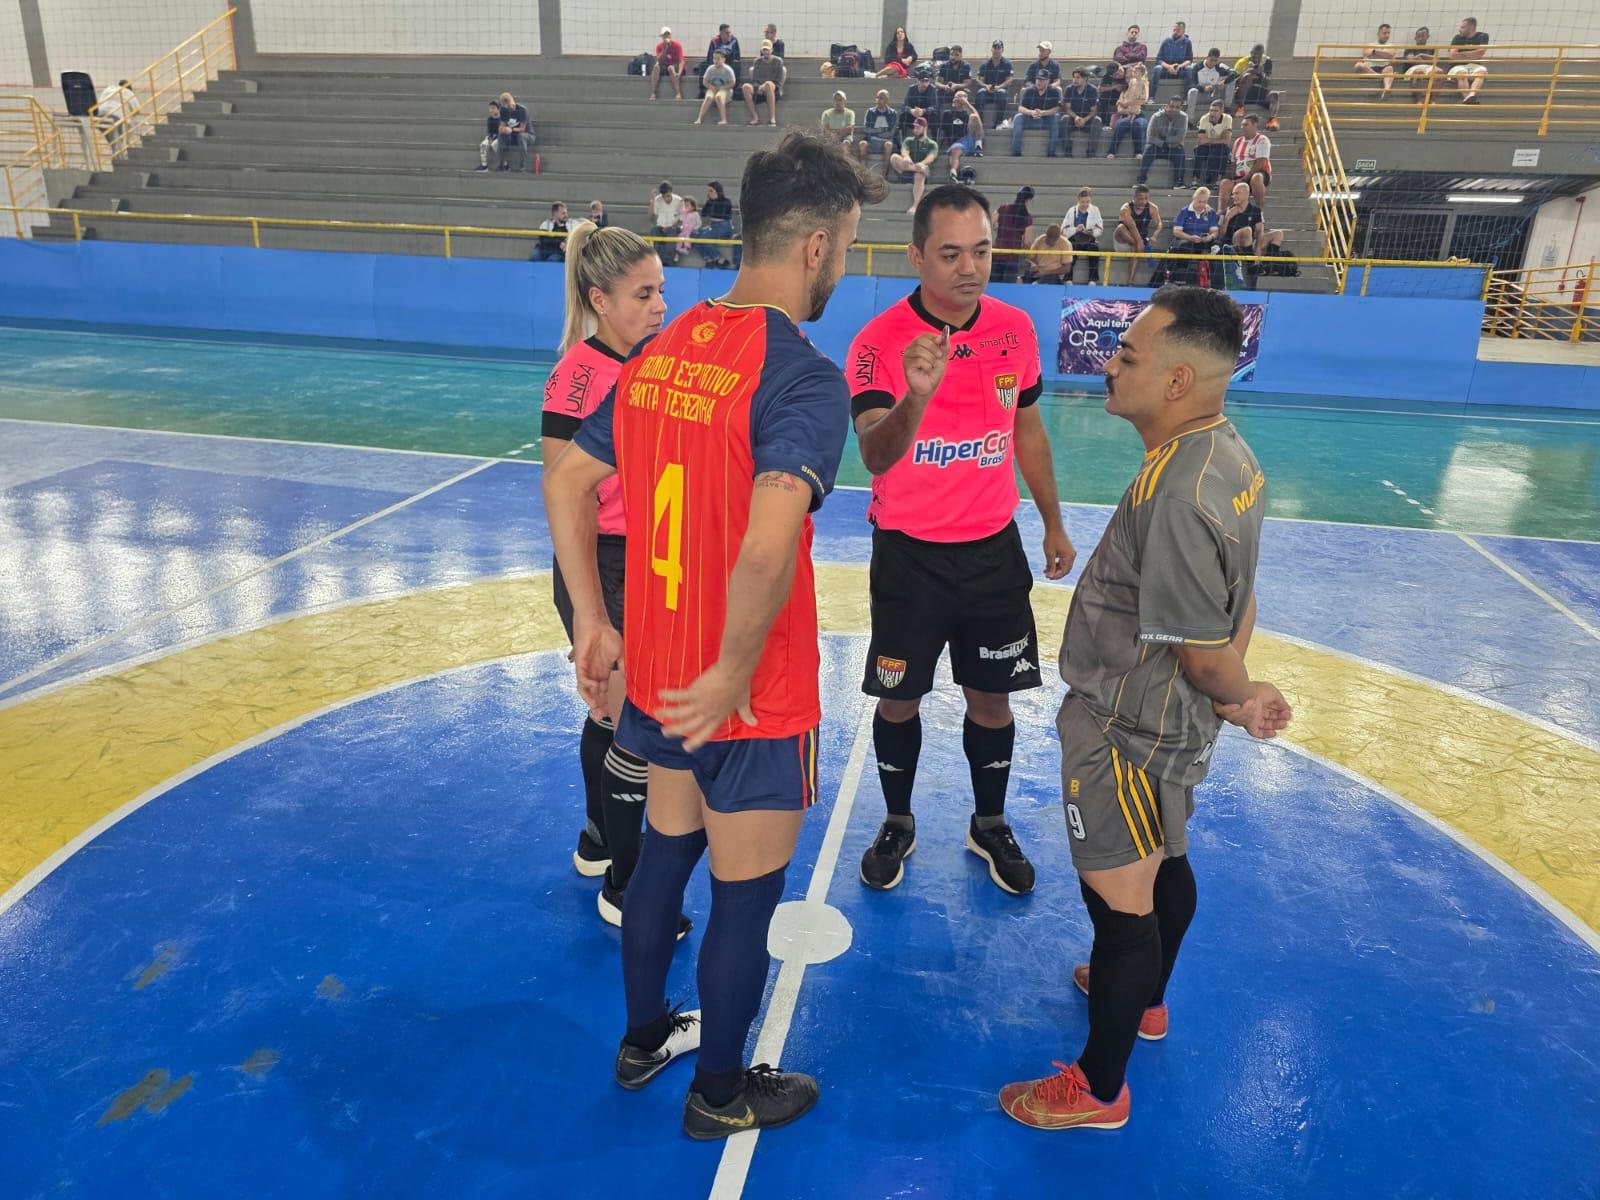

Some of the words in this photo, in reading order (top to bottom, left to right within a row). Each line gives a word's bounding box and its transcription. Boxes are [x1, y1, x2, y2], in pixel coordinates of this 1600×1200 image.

[1087, 319, 1109, 329] Aqui
[999, 376, 1015, 386] FPF
[651, 462, 684, 612] 4
[1155, 633, 1184, 643] GEAR
[881, 659, 901, 669] FPF
[1067, 802, 1087, 841] 9
